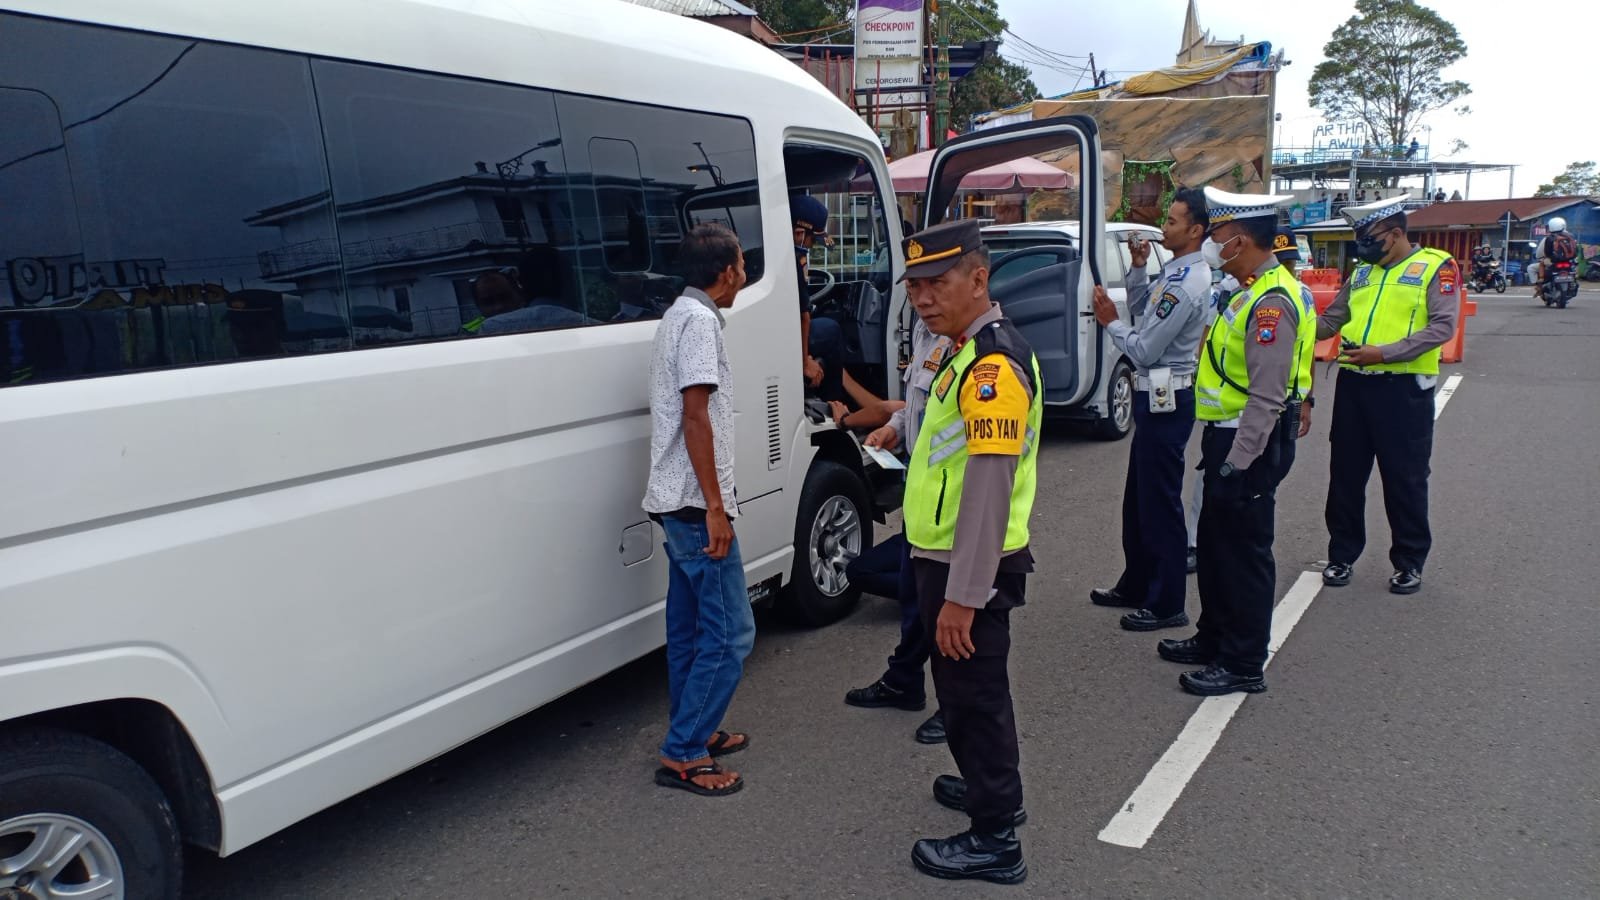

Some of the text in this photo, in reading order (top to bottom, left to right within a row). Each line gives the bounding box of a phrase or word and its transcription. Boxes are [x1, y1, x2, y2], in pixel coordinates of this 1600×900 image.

[864, 22, 915, 32] CHECKPOINT
[1319, 137, 1359, 150] LAWU
[974, 418, 993, 440] POS
[996, 418, 1019, 440] YAN
